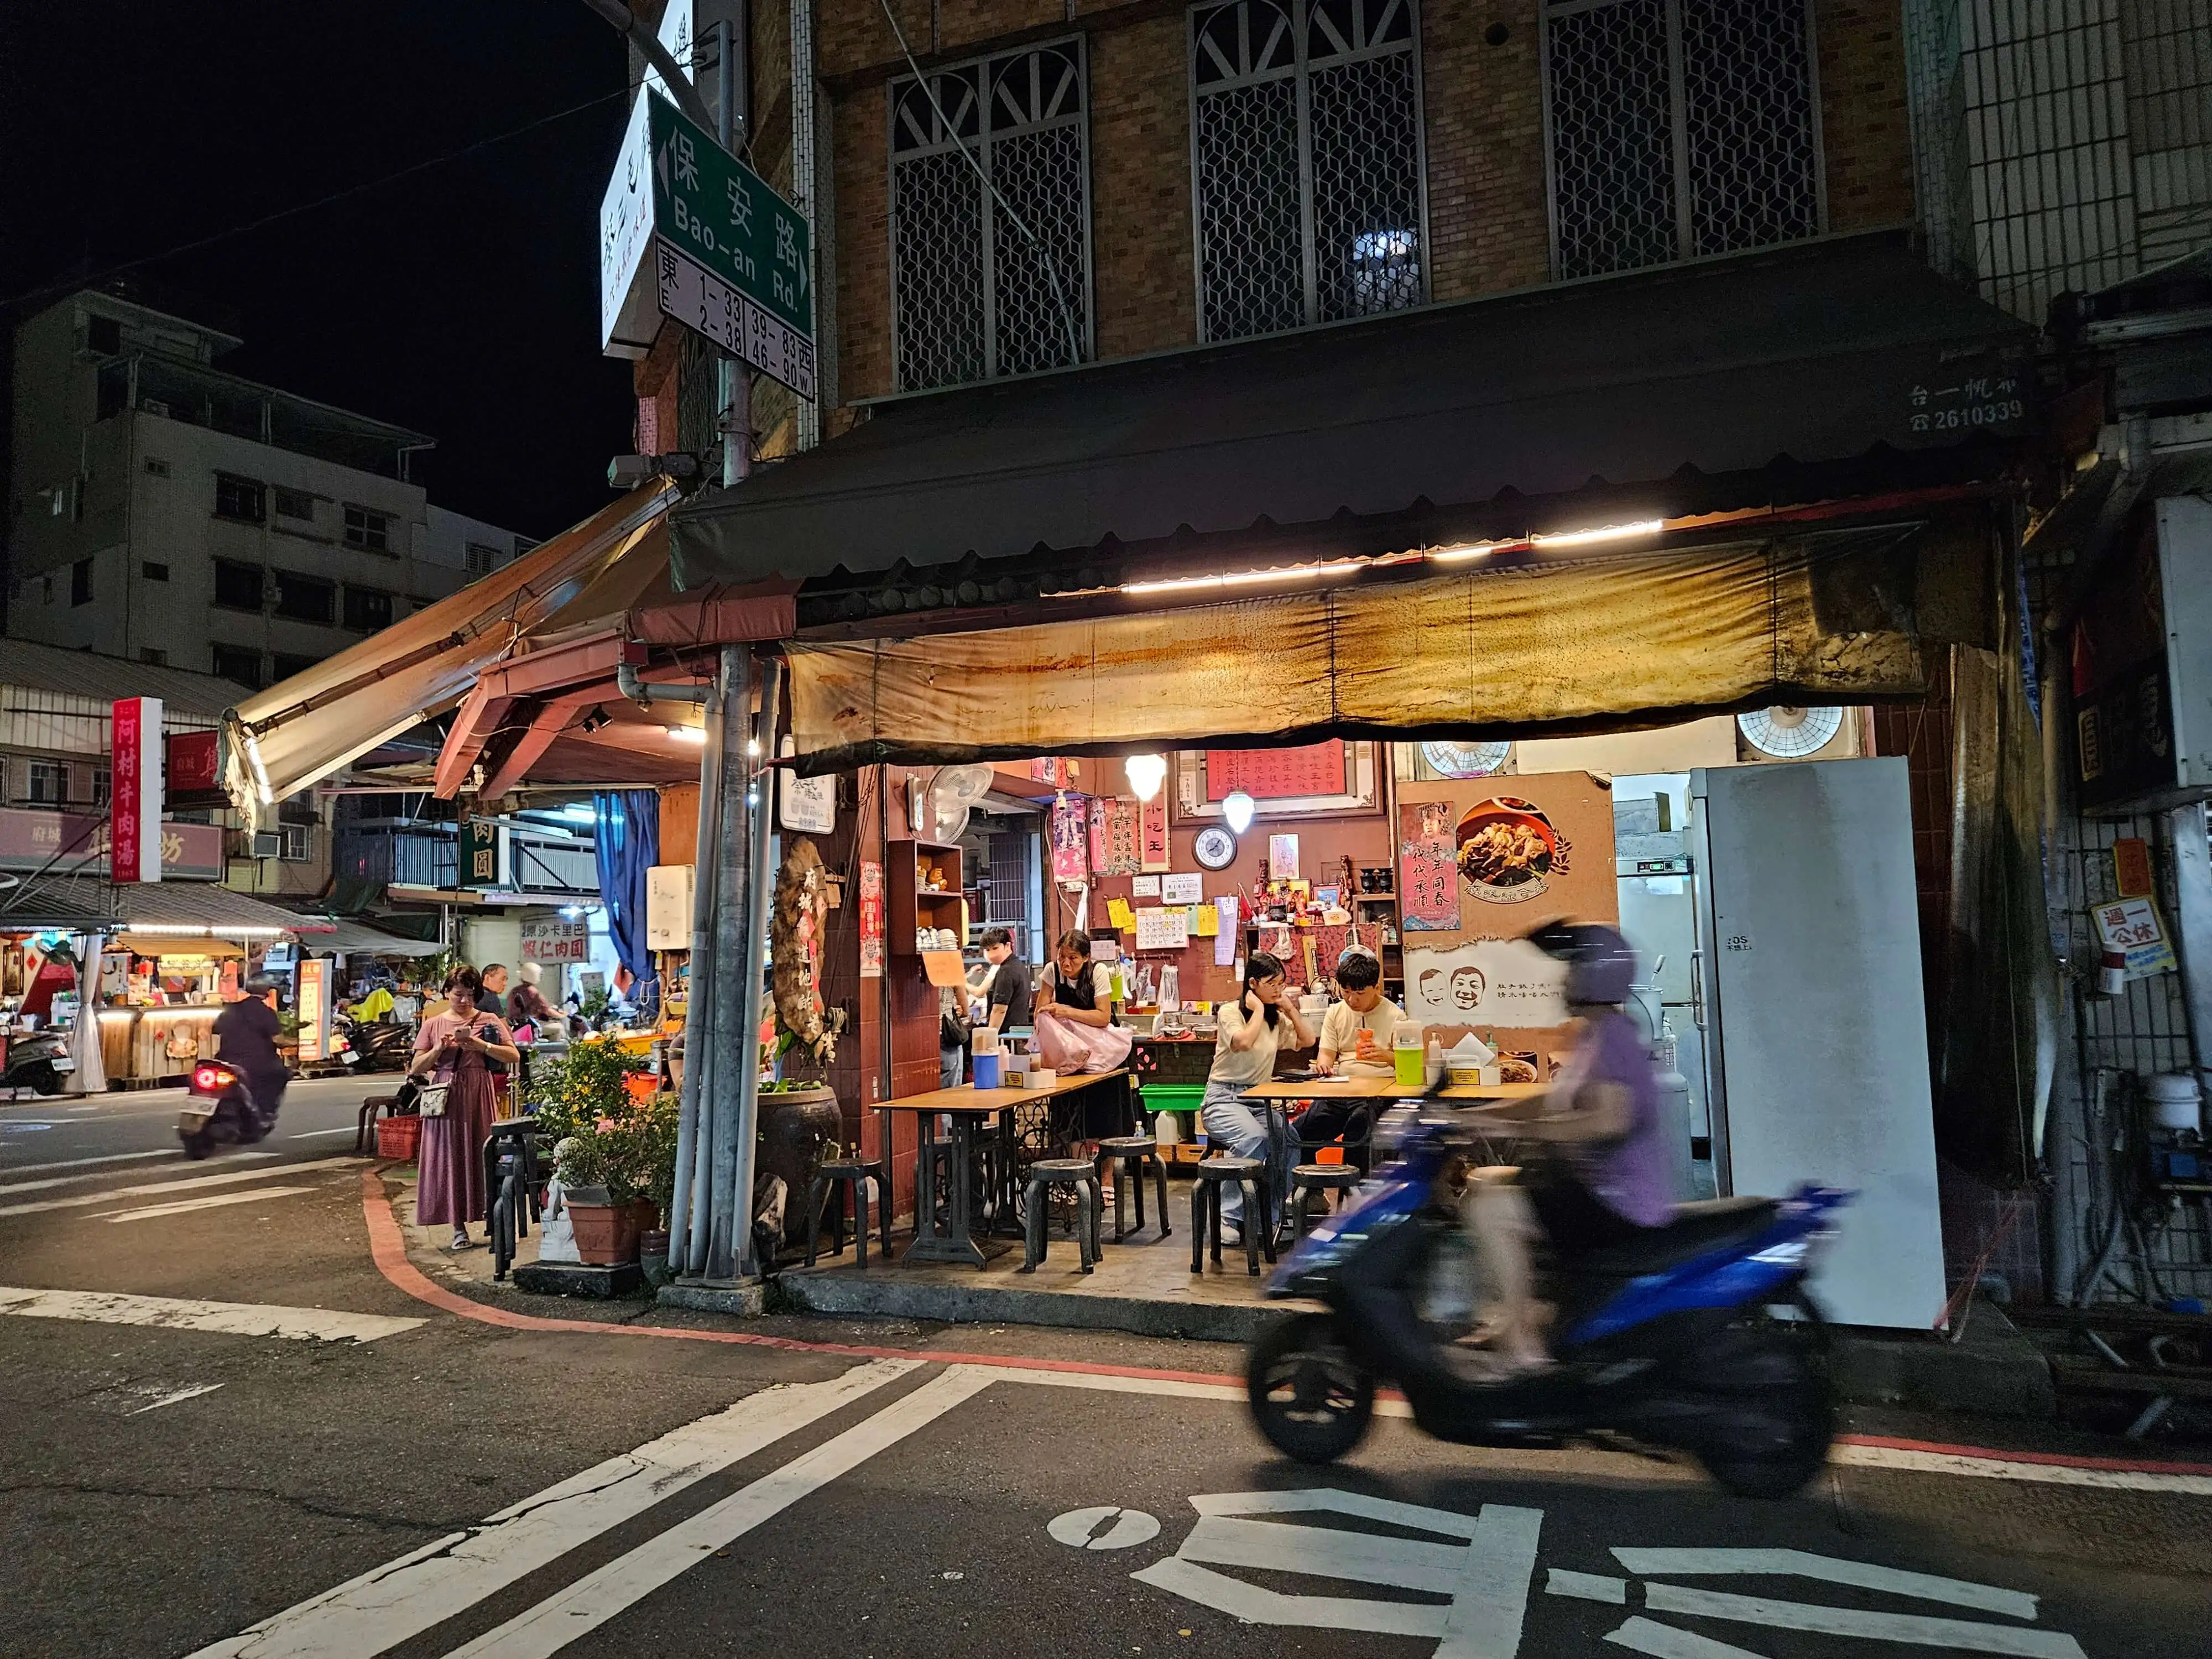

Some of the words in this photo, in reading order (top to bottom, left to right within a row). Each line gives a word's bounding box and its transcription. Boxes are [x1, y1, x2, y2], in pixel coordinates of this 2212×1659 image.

[670, 126, 797, 273] 保安路
[659, 248, 680, 290] 東
[674, 195, 755, 282] Bao-an
[773, 269, 798, 313] Rd.
[661, 287, 674, 311] E.
[797, 340, 812, 375] 西
[800, 374, 811, 395] W.
[1934, 399, 2024, 430] 2610339
[117, 718, 136, 867] 阿村牛肉湯
[32, 826, 61, 843] 府城
[1146, 805, 1164, 852] 小吃王
[1413, 847, 1430, 908] 代代承順
[1431, 841, 1451, 907] 年年同春
[2103, 906, 2147, 927] 週一
[2110, 921, 2154, 943] 公休
[523, 938, 584, 959] 蝦仁肉圓
